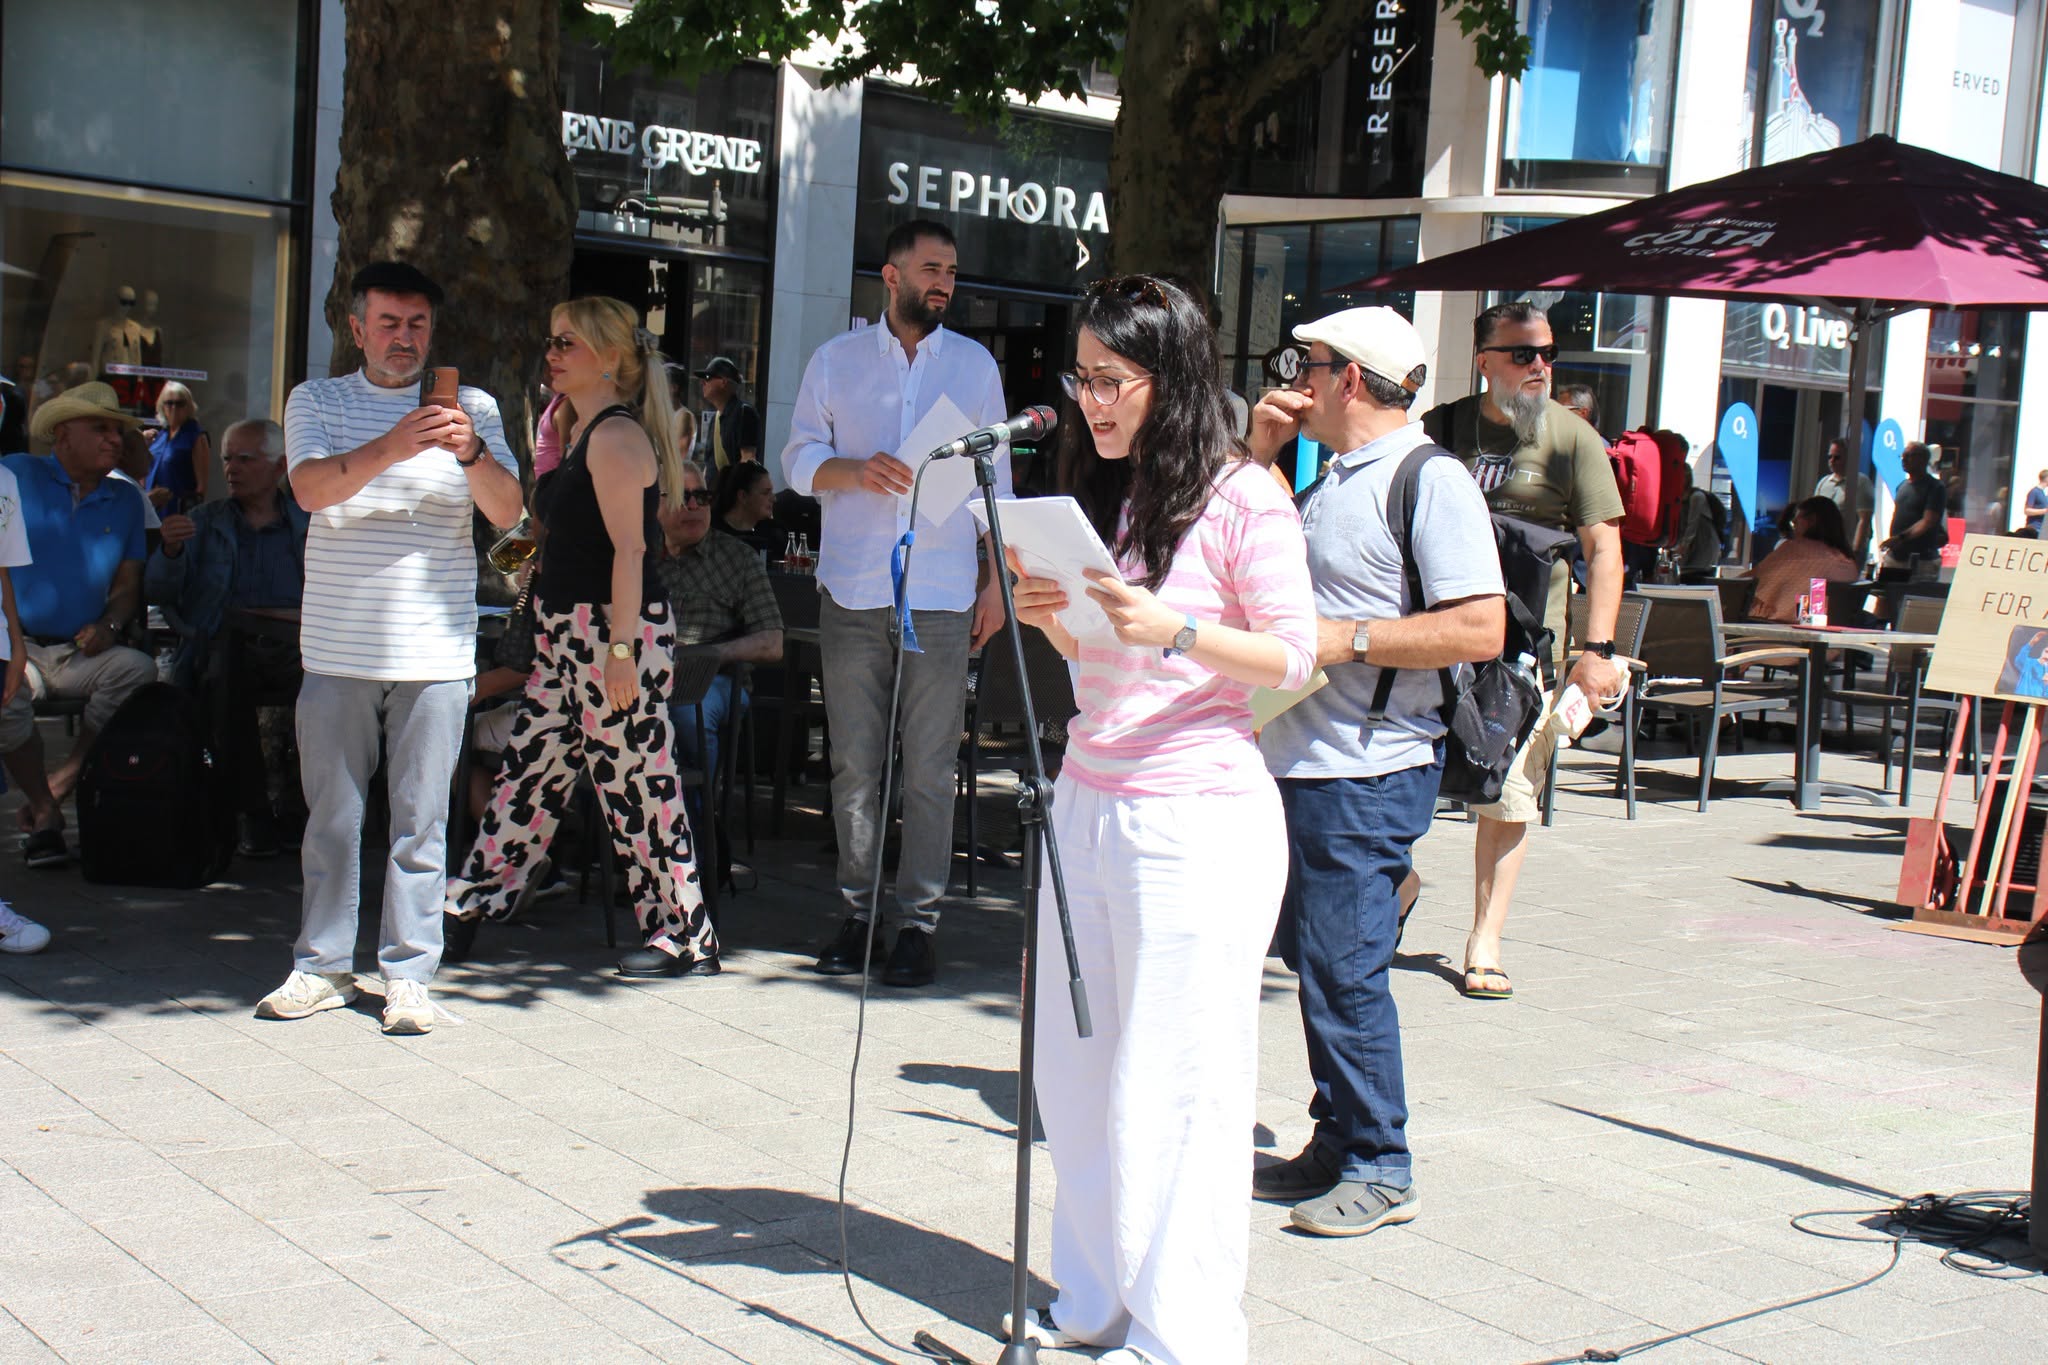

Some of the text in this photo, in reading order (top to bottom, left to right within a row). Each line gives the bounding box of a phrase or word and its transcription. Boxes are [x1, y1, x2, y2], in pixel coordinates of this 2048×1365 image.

[1952, 70, 2001, 96] ERVED
[561, 111, 761, 176] ENE GRENE
[887, 161, 1110, 234] SEPHORA
[1623, 227, 1776, 248] COSTA
[1630, 246, 1717, 257] COFFEE
[1793, 305, 1849, 350] Live
[1981, 591, 2032, 619] FÜR
